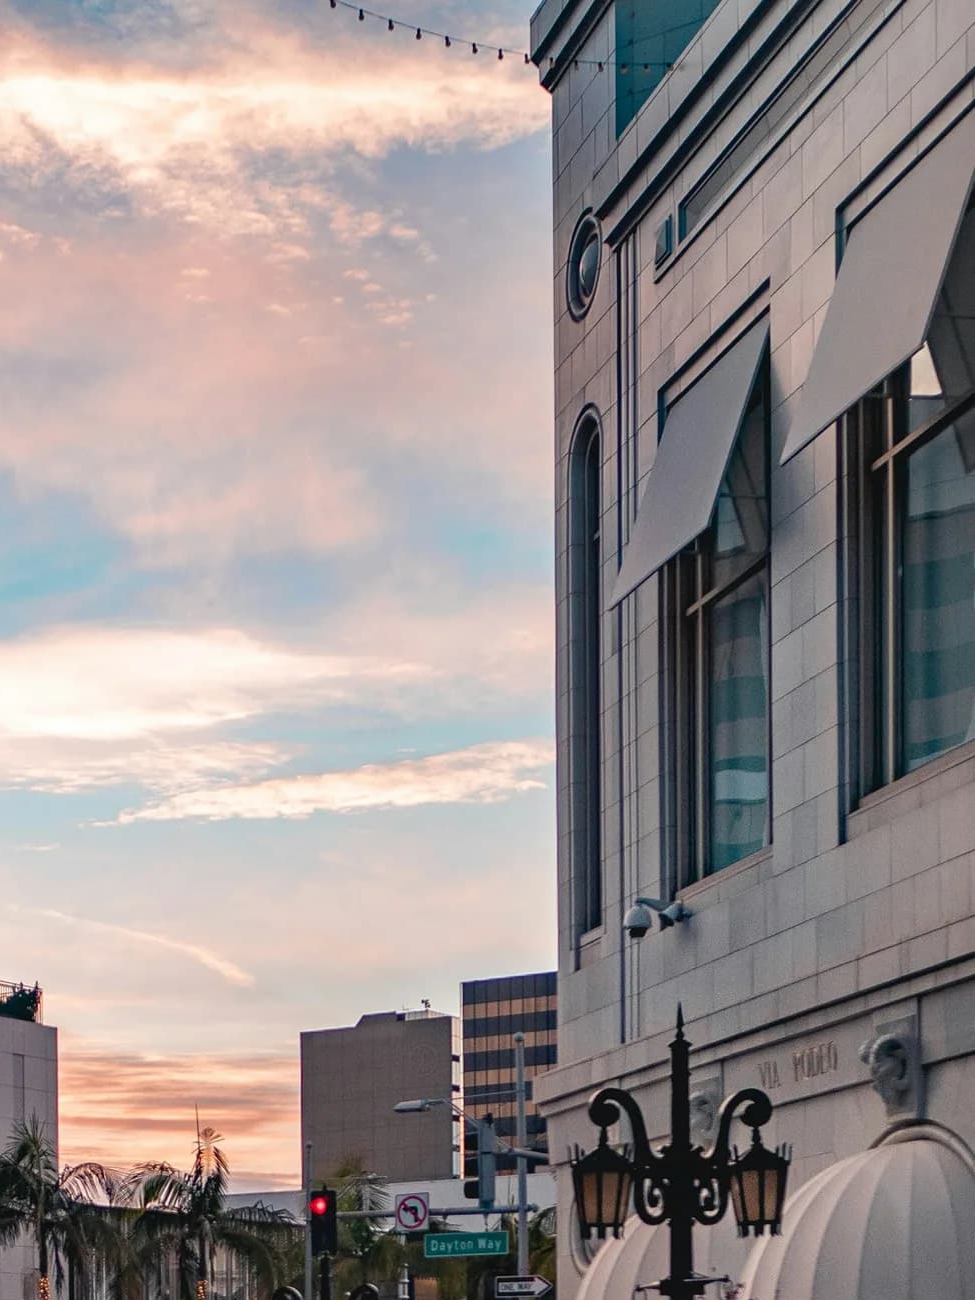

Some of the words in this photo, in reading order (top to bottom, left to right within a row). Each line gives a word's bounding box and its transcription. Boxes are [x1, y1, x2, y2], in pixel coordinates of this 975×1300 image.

[757, 1060, 781, 1088] VIA
[792, 1040, 838, 1082] RODEO
[430, 1239, 474, 1252] Dayton
[477, 1238, 503, 1251] Way
